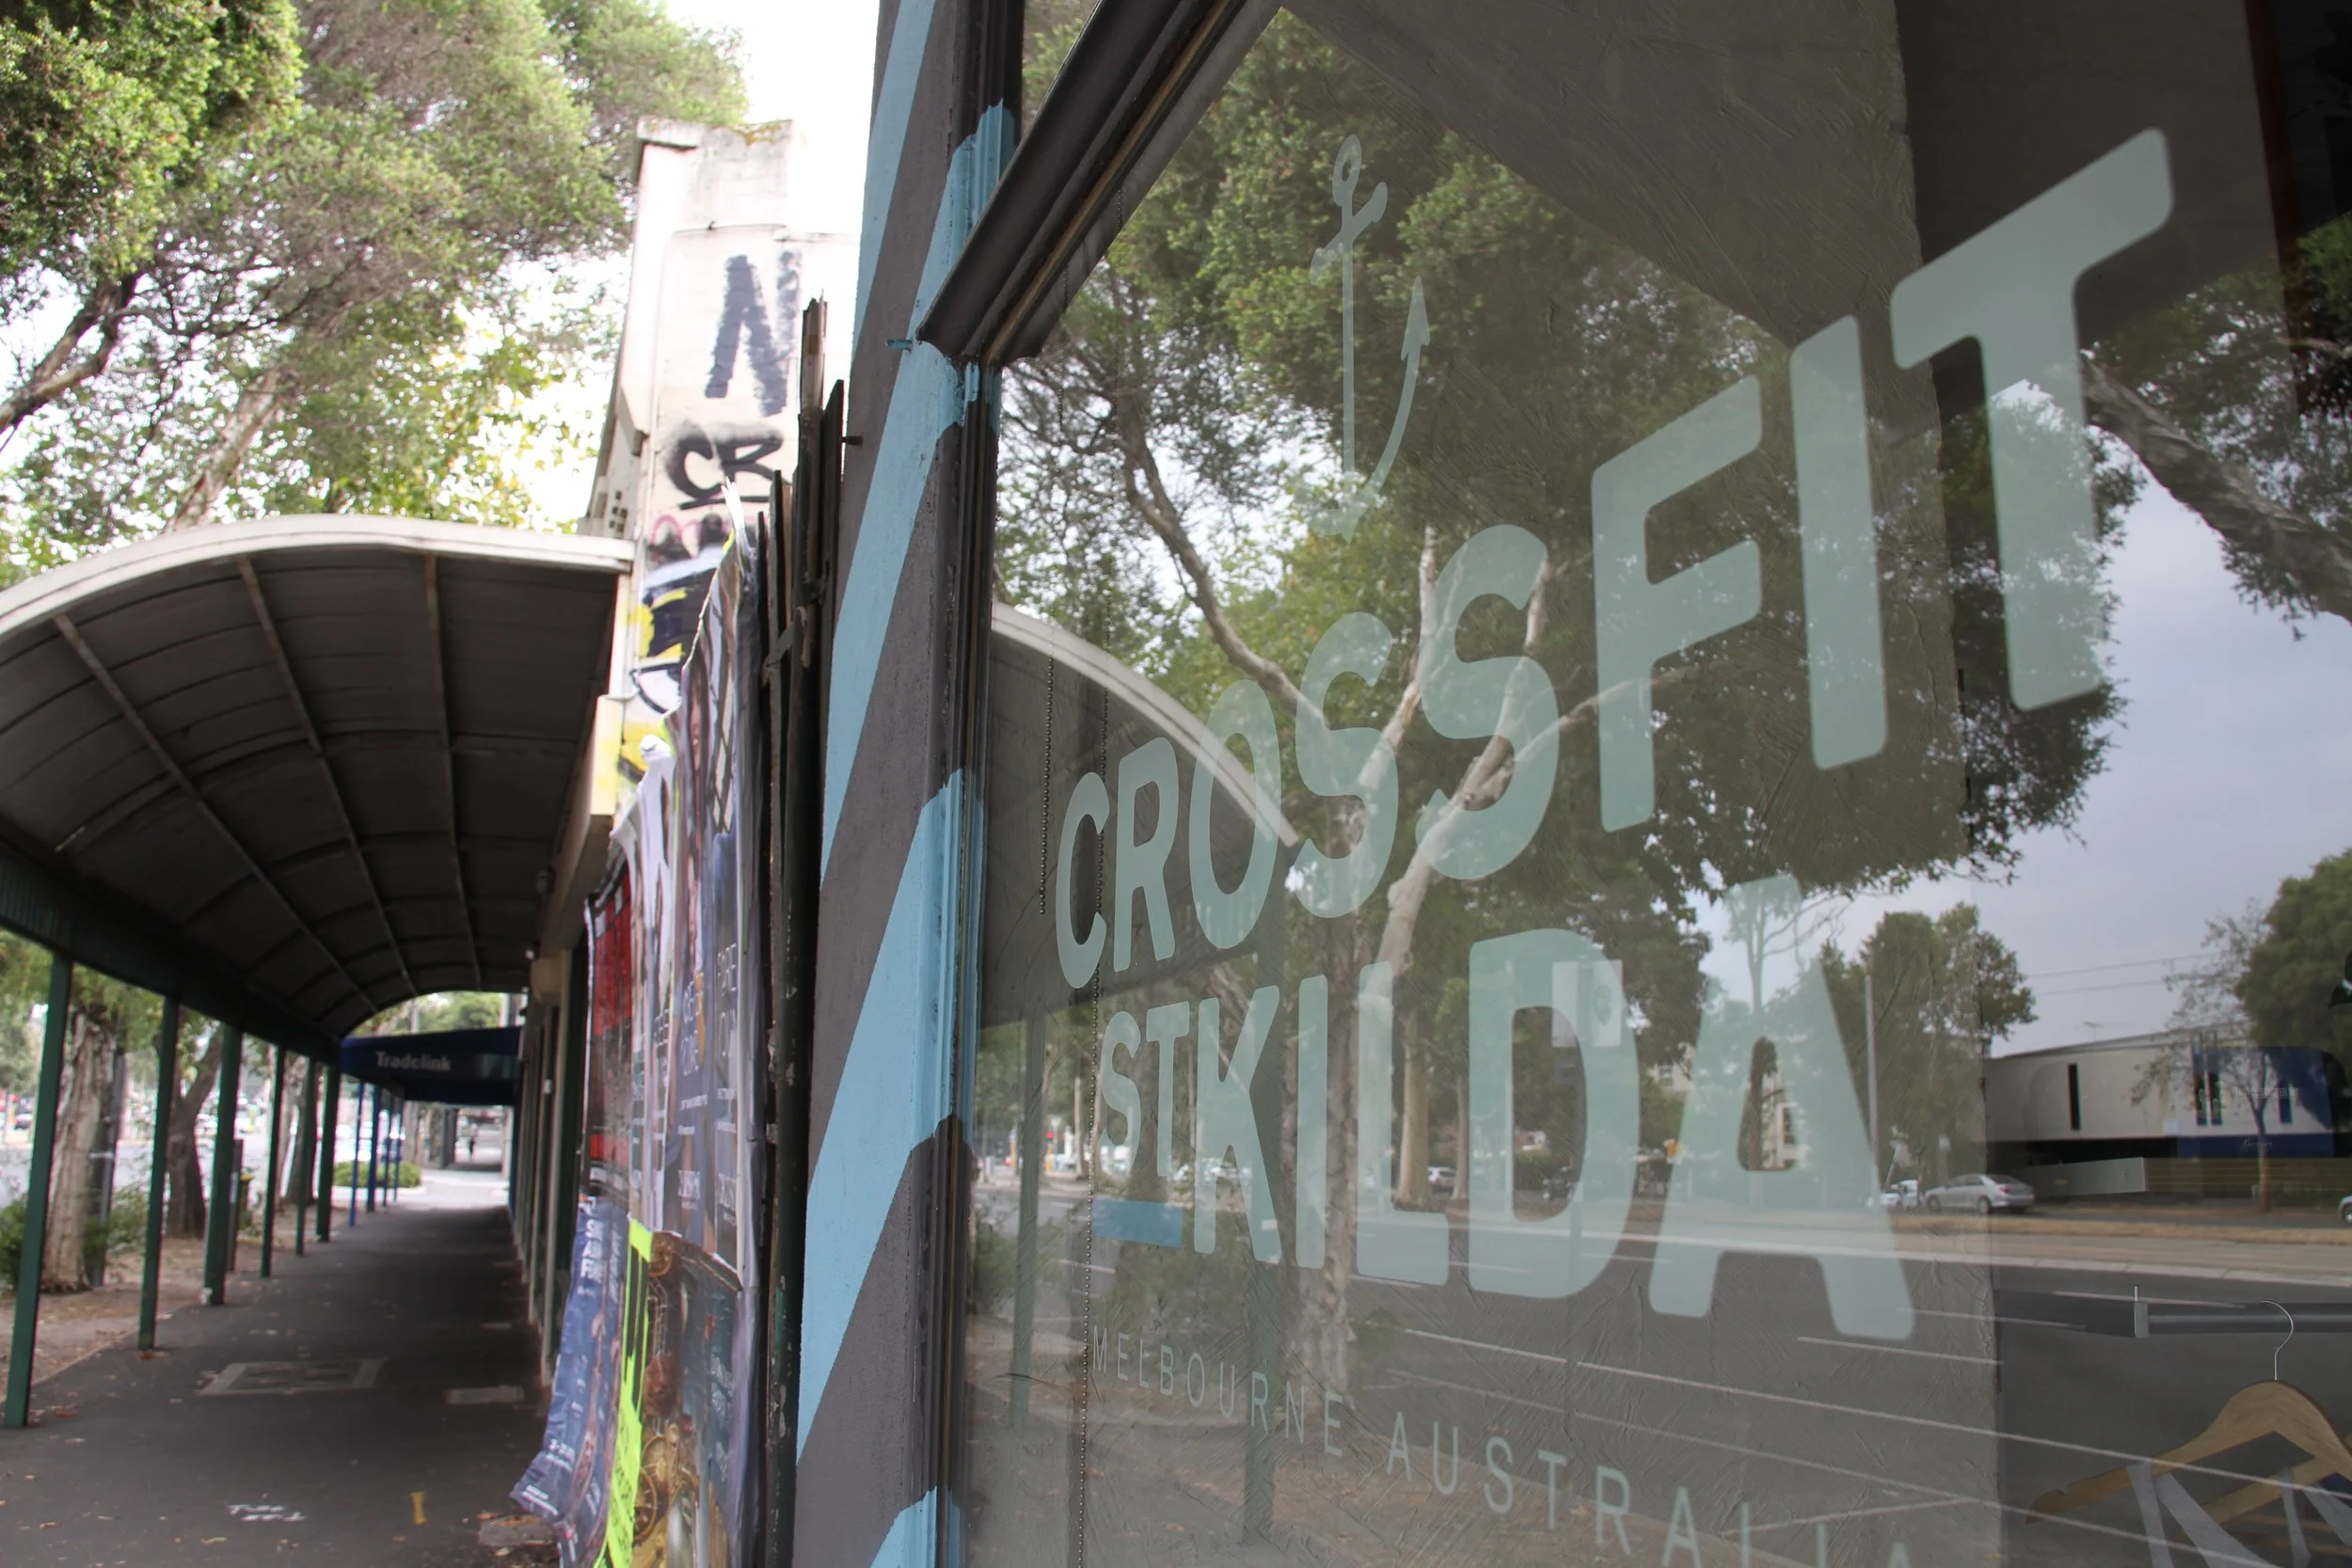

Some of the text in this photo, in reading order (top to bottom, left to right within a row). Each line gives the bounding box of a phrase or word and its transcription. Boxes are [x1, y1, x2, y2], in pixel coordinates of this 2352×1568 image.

[1057, 127, 2174, 989] CROSSFIT
[1099, 875, 1915, 1340] ST KILDA
[1092, 1324, 1912, 1568] MELBOURNE AUSTRA
